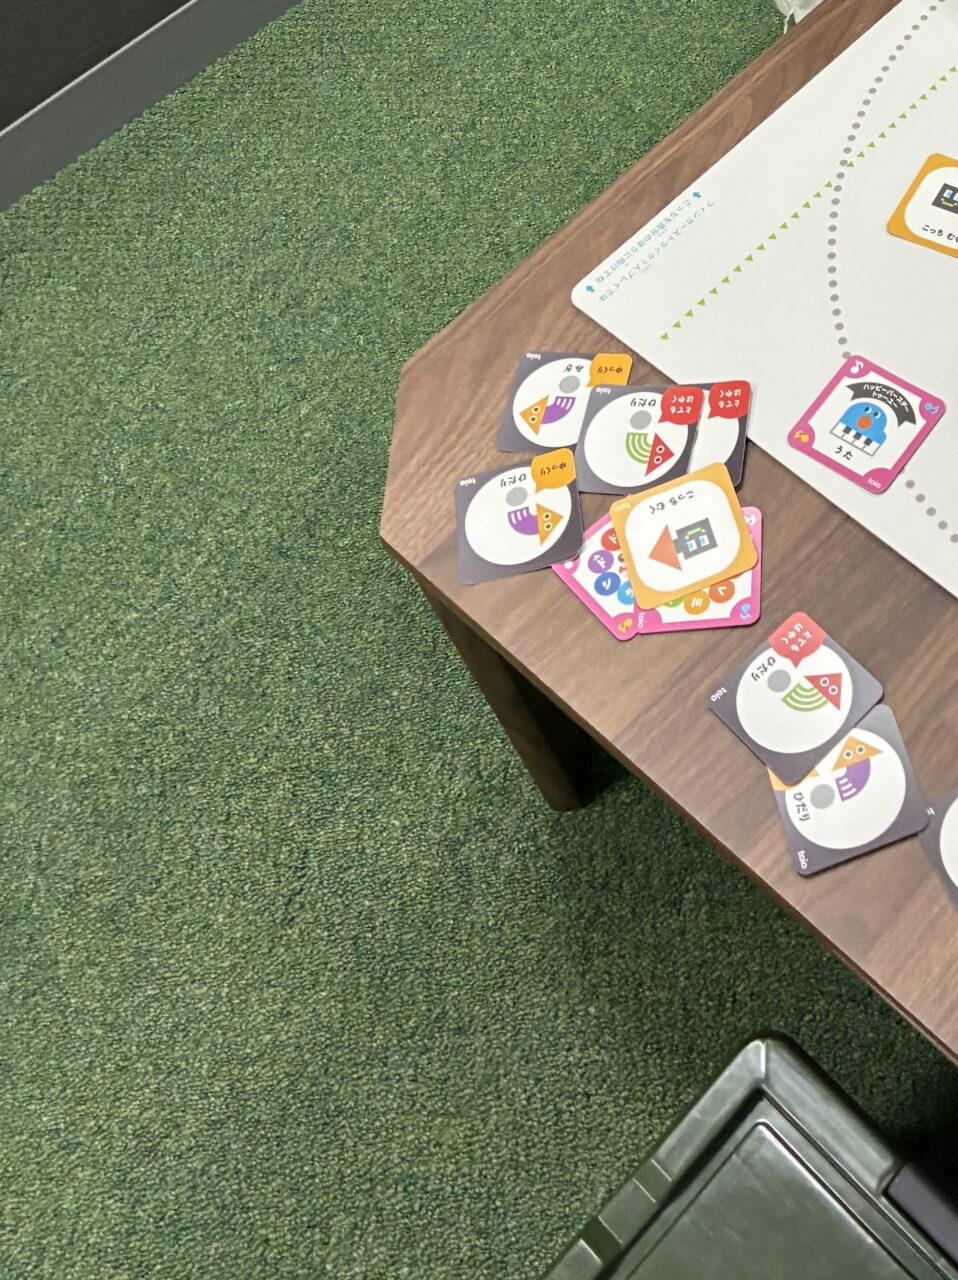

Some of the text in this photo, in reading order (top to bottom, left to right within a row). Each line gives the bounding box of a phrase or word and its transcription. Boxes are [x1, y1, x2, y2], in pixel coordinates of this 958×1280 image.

[922, 224, 944, 237] こっち
[526, 352, 541, 360] toio
[563, 363, 584, 373] みぎ
[597, 366, 623, 374] ゆっくり
[595, 386, 611, 395] toio
[719, 389, 742, 398] はやく
[630, 398, 657, 407] ひだり
[672, 395, 694, 404] はやく
[718, 400, 741, 409] とても
[670, 406, 692, 414] とても
[835, 445, 853, 460] うた
[540, 462, 566, 476] ゆっくり
[460, 477, 476, 487] toio
[500, 473, 527, 487] ひだり
[867, 477, 882, 489] toio
[649, 490, 694, 515] こっち むく
[781, 622, 804, 645] はやく
[790, 631, 812, 652] とても
[751, 656, 777, 681] ひだり
[710, 687, 728, 702] toio
[793, 791, 811, 822] ひだり
[797, 849, 809, 870] toio
